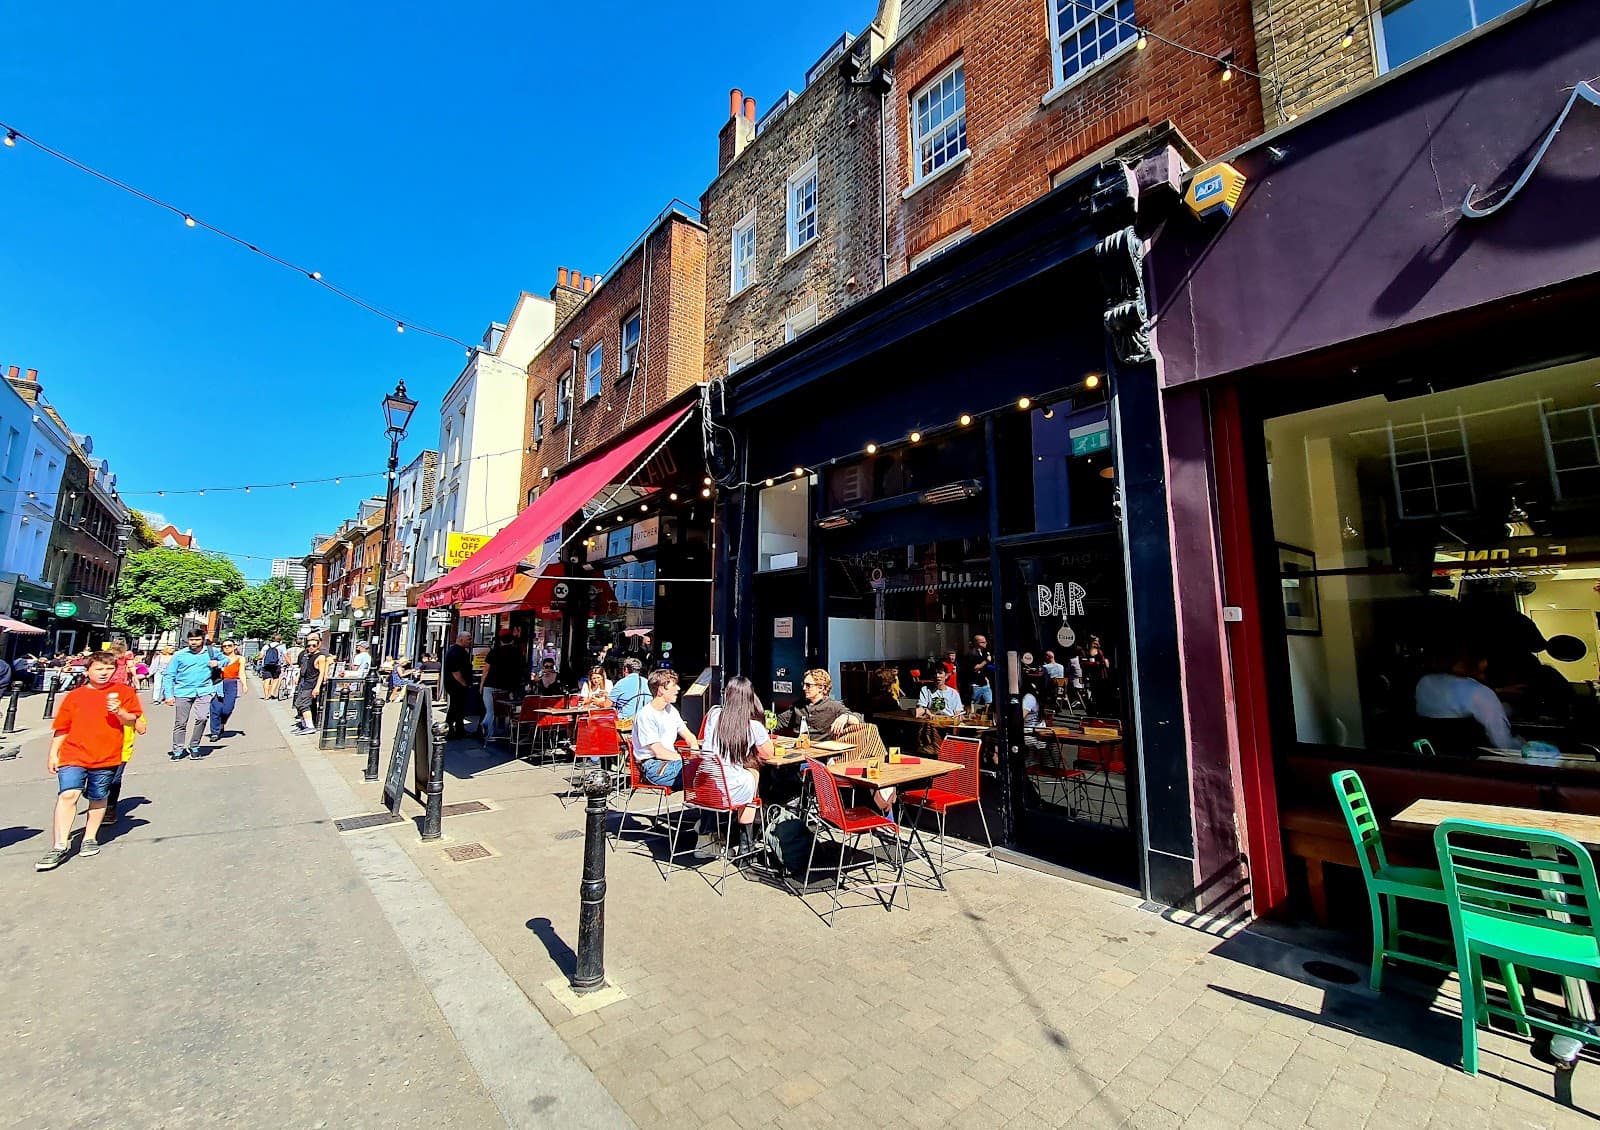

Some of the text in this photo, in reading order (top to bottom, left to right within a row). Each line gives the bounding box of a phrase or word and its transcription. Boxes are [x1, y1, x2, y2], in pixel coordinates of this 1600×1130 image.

[1196, 180, 1220, 197] ADT
[461, 542, 479, 551] OFF
[1037, 582, 1087, 616] BAR
